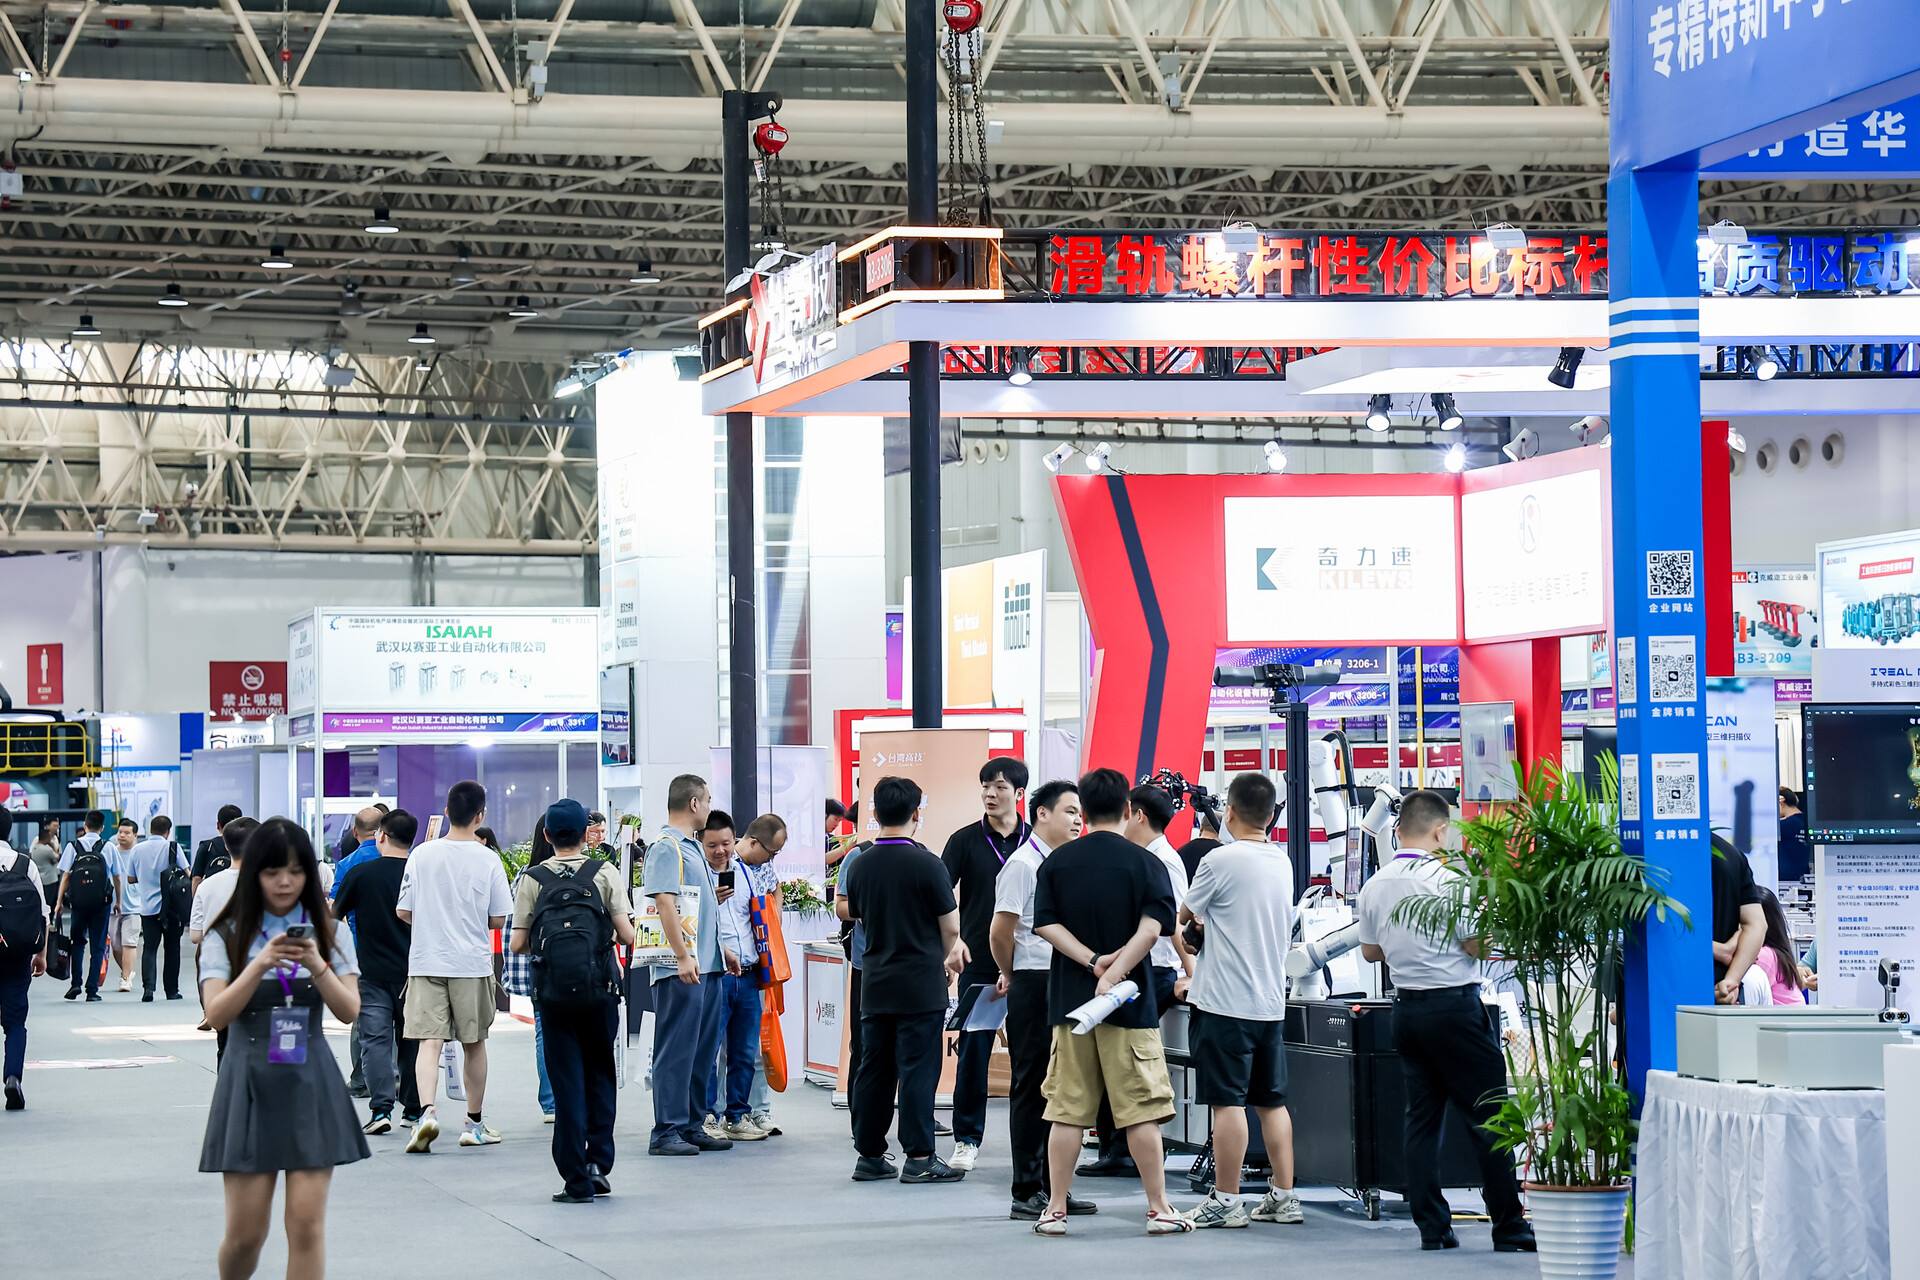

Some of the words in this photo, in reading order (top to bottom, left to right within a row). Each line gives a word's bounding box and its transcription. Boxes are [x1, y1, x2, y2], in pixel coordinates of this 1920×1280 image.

[1647, 0, 1852, 78] 专精特新
[1318, 547, 1411, 566] 奇力速
[1648, 602, 1694, 613] 企业网站
[426, 625, 492, 639] ISAIAH
[376, 641, 546, 653] 武汉以赛亚工业自动化有限公司
[1346, 659, 1379, 669] 3206-1
[1737, 653, 1791, 664] B3-3209
[1870, 667, 1913, 676] IREAL
[222, 693, 283, 707] 禁止吸烟
[221, 707, 237, 717] NO
[240, 707, 285, 717] SMOKING
[1651, 707, 1696, 718] 金牌销售
[1655, 829, 1699, 840] 金牌销售
